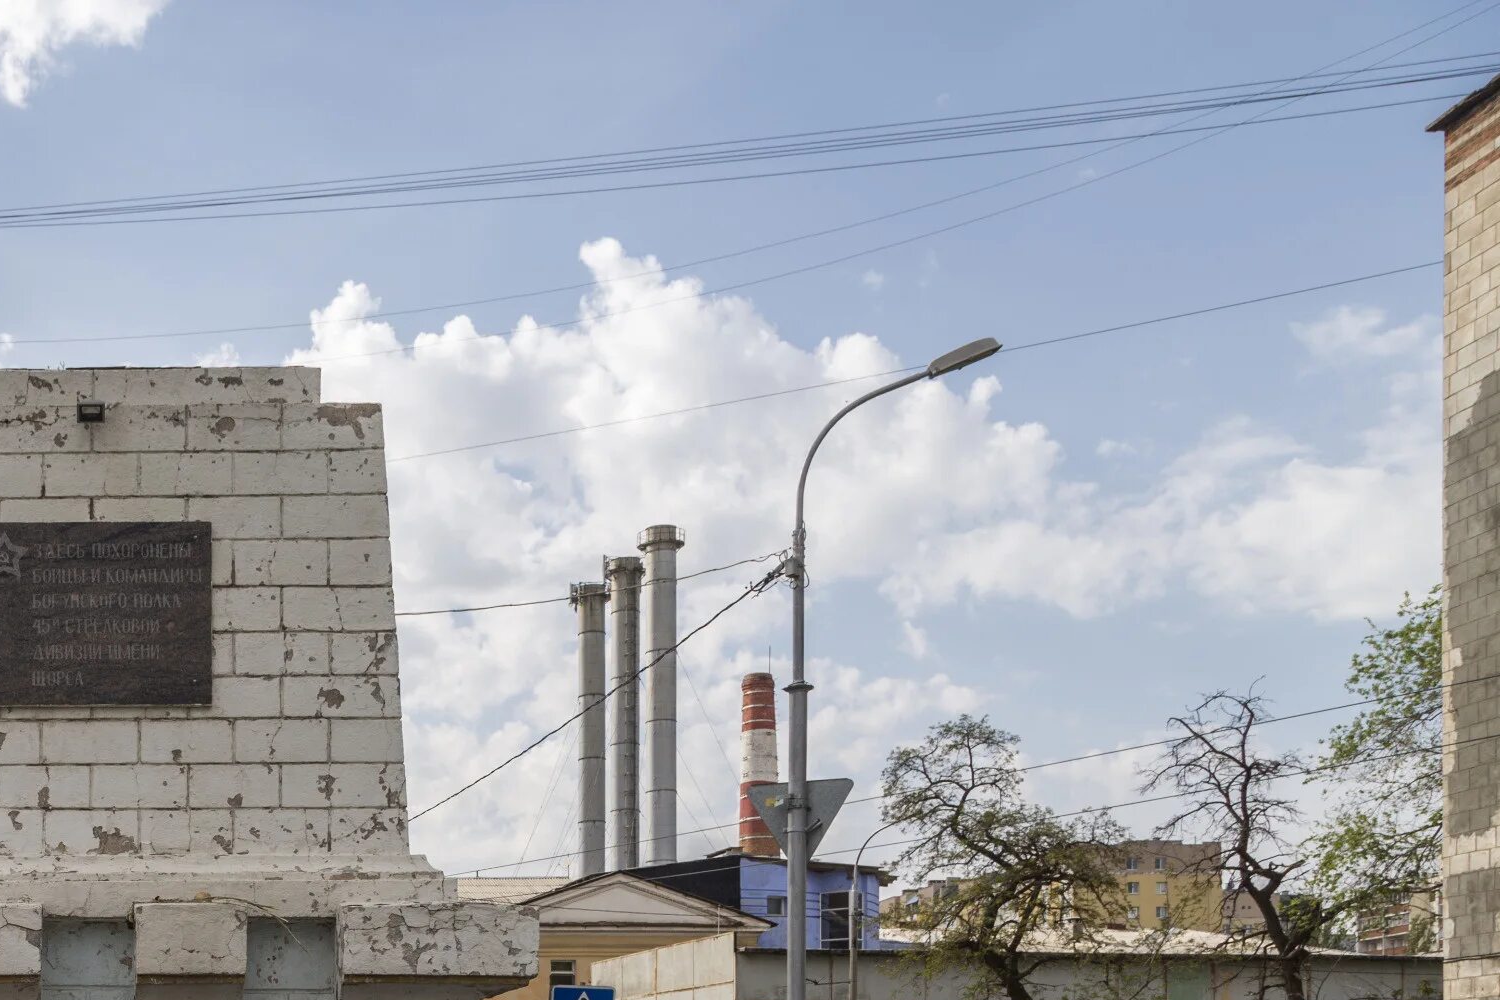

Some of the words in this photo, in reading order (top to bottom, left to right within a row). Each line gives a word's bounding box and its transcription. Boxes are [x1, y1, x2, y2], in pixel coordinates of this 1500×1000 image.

[34, 542, 85, 559] ЗДЕСЬ
[92, 542, 193, 559] ПОХОРОНЕНЫ
[31, 567, 85, 584] БОЙЦЫ
[91, 567, 102, 584] И
[105, 567, 203, 584] КОМАНДИРЫ
[32, 593, 128, 609] БОГУНСКОГО
[133, 593, 182, 609] ПОЛКА
[64, 618, 160, 635] СТРЕЛКОВОЙ
[33, 644, 103, 661] ДИВИЗИИ
[107, 644, 160, 661] ИМЕНИ
